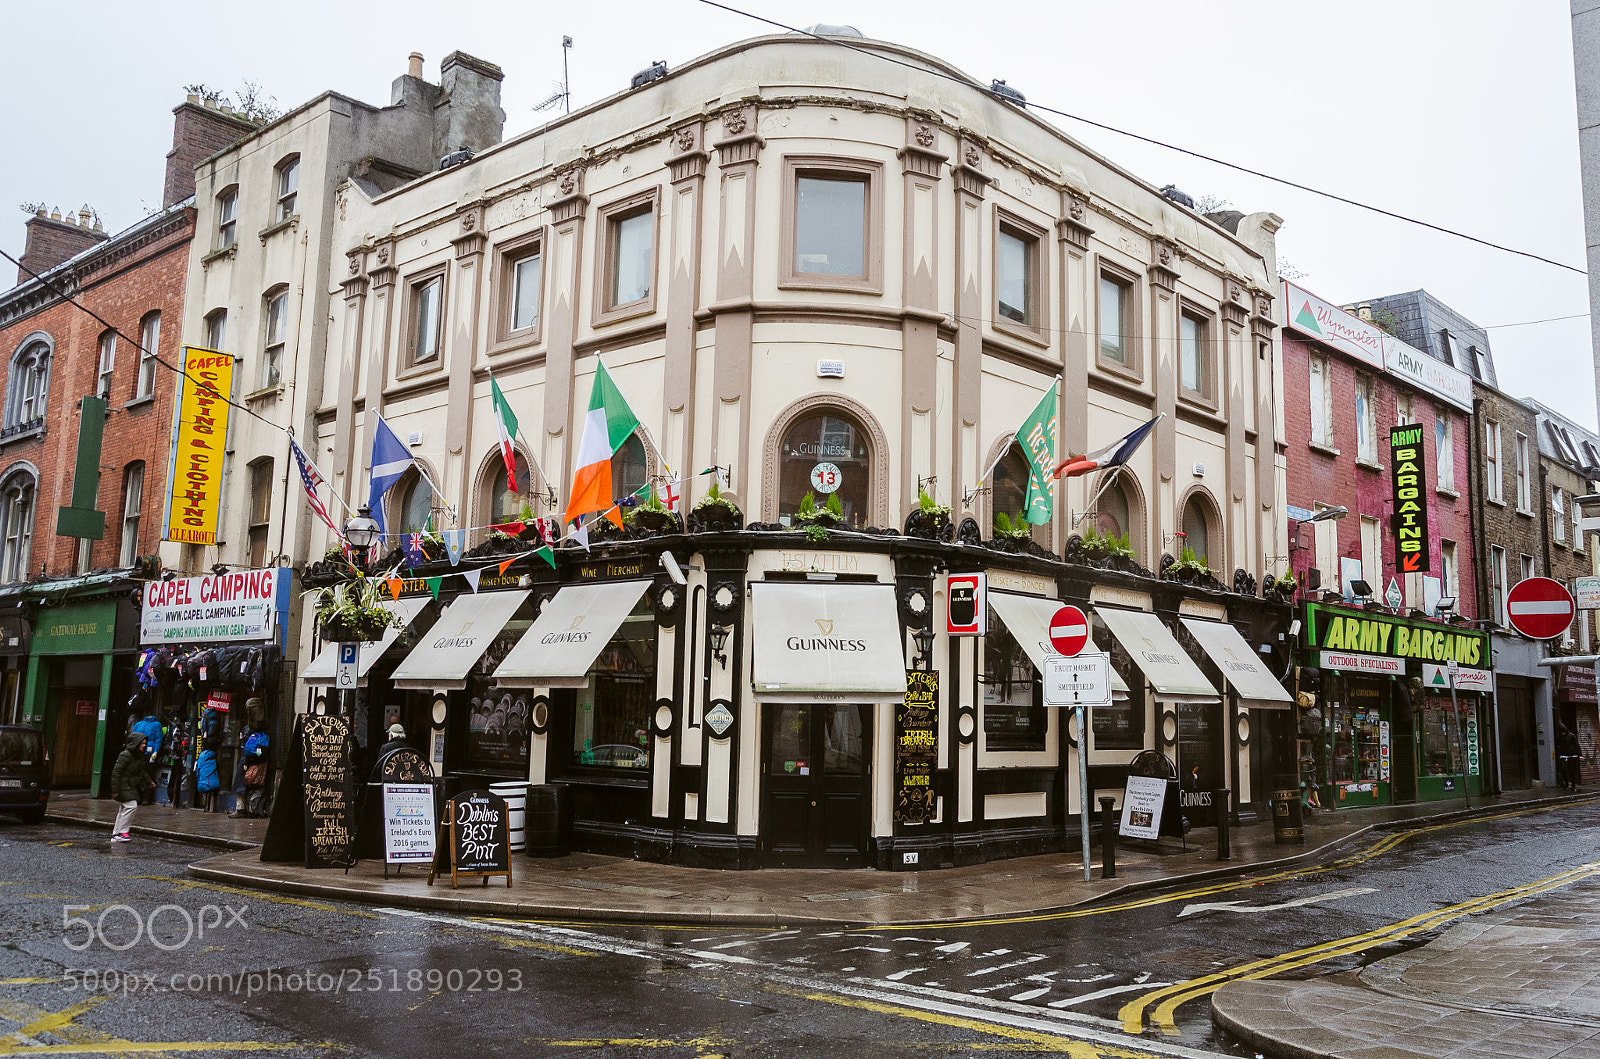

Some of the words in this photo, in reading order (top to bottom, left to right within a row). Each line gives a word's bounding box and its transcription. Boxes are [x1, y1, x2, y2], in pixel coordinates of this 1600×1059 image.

[1317, 306, 1378, 349] Wynnster
[188, 356, 232, 370] CAPEL
[1398, 352, 1424, 378] ARMY
[192, 372, 221, 435] CAMPING
[1391, 428, 1422, 447] ARMY
[799, 442, 846, 456] GUINNESS
[817, 471, 836, 484] 13
[182, 454, 209, 526] CLOTHING
[1396, 448, 1421, 552] BARGAINS
[170, 528, 217, 544] CLEAROUT
[148, 579, 192, 608] CAPEL
[200, 570, 272, 603] CAMPING
[165, 609, 203, 622] WWW.CAPEL
[205, 605, 245, 621] CAMPING.IE
[78, 622, 97, 635] HOUSE
[163, 628, 184, 639] CAMPING
[184, 626, 200, 638] HIKING
[201, 626, 209, 637] SKI
[214, 625, 229, 636] WORK
[230, 624, 244, 635] GEAR
[433, 637, 477, 649] GUINNESS
[541, 632, 591, 645] GUINNESS
[786, 637, 866, 652] GUINNESS
[1323, 616, 1392, 653] ARMY
[1394, 626, 1481, 666] BARGAINS
[344, 647, 353, 661] P
[1142, 651, 1180, 665] GUINNESS
[1073, 664, 1097, 672] MARKET
[1328, 655, 1359, 667] OUTDOOR
[1360, 658, 1399, 671] SPECIALISTS
[329, 735, 344, 744] BAR
[904, 730, 933, 738] IRISH
[1179, 789, 1212, 807] GUINNESS
[457, 802, 499, 824] Dublin's
[389, 818, 401, 826] Win
[403, 818, 423, 826] Tickets
[424, 818, 431, 826] to
[316, 827, 348, 836] IRISH
[462, 823, 498, 841] BEST
[311, 835, 349, 846] BREAKFAST
[393, 839, 409, 847] 2016
[410, 840, 429, 848] games
